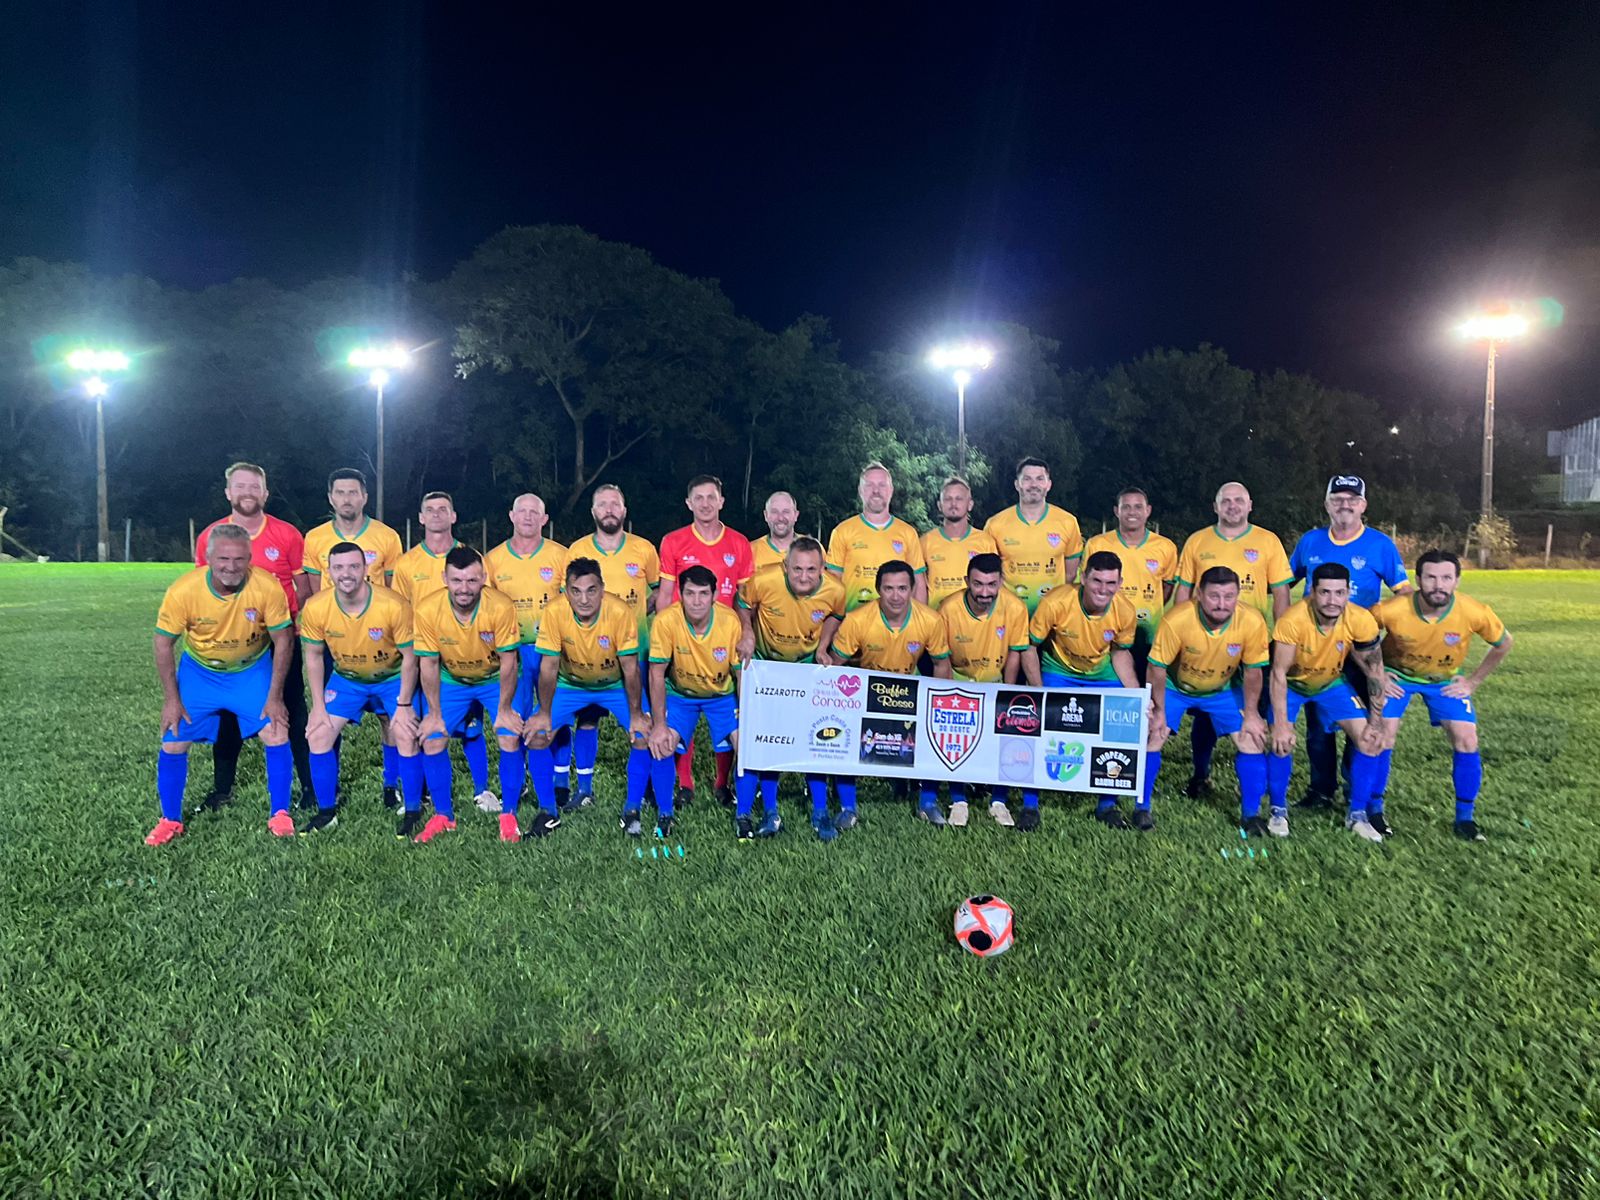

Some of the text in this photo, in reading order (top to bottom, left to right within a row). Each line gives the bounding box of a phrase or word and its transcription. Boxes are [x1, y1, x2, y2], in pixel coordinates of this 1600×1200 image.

[755, 687, 806, 698] LAZZAROTTO
[871, 683, 909, 697] Buffet
[812, 695, 862, 710] Coração
[877, 695, 914, 709] Rosso
[1462, 699, 1472, 713] 7
[934, 708, 976, 726] ESTRELA
[1061, 712, 1083, 723] ARENA
[755, 734, 795, 745] MAECELI
[946, 744, 962, 752] 1972
